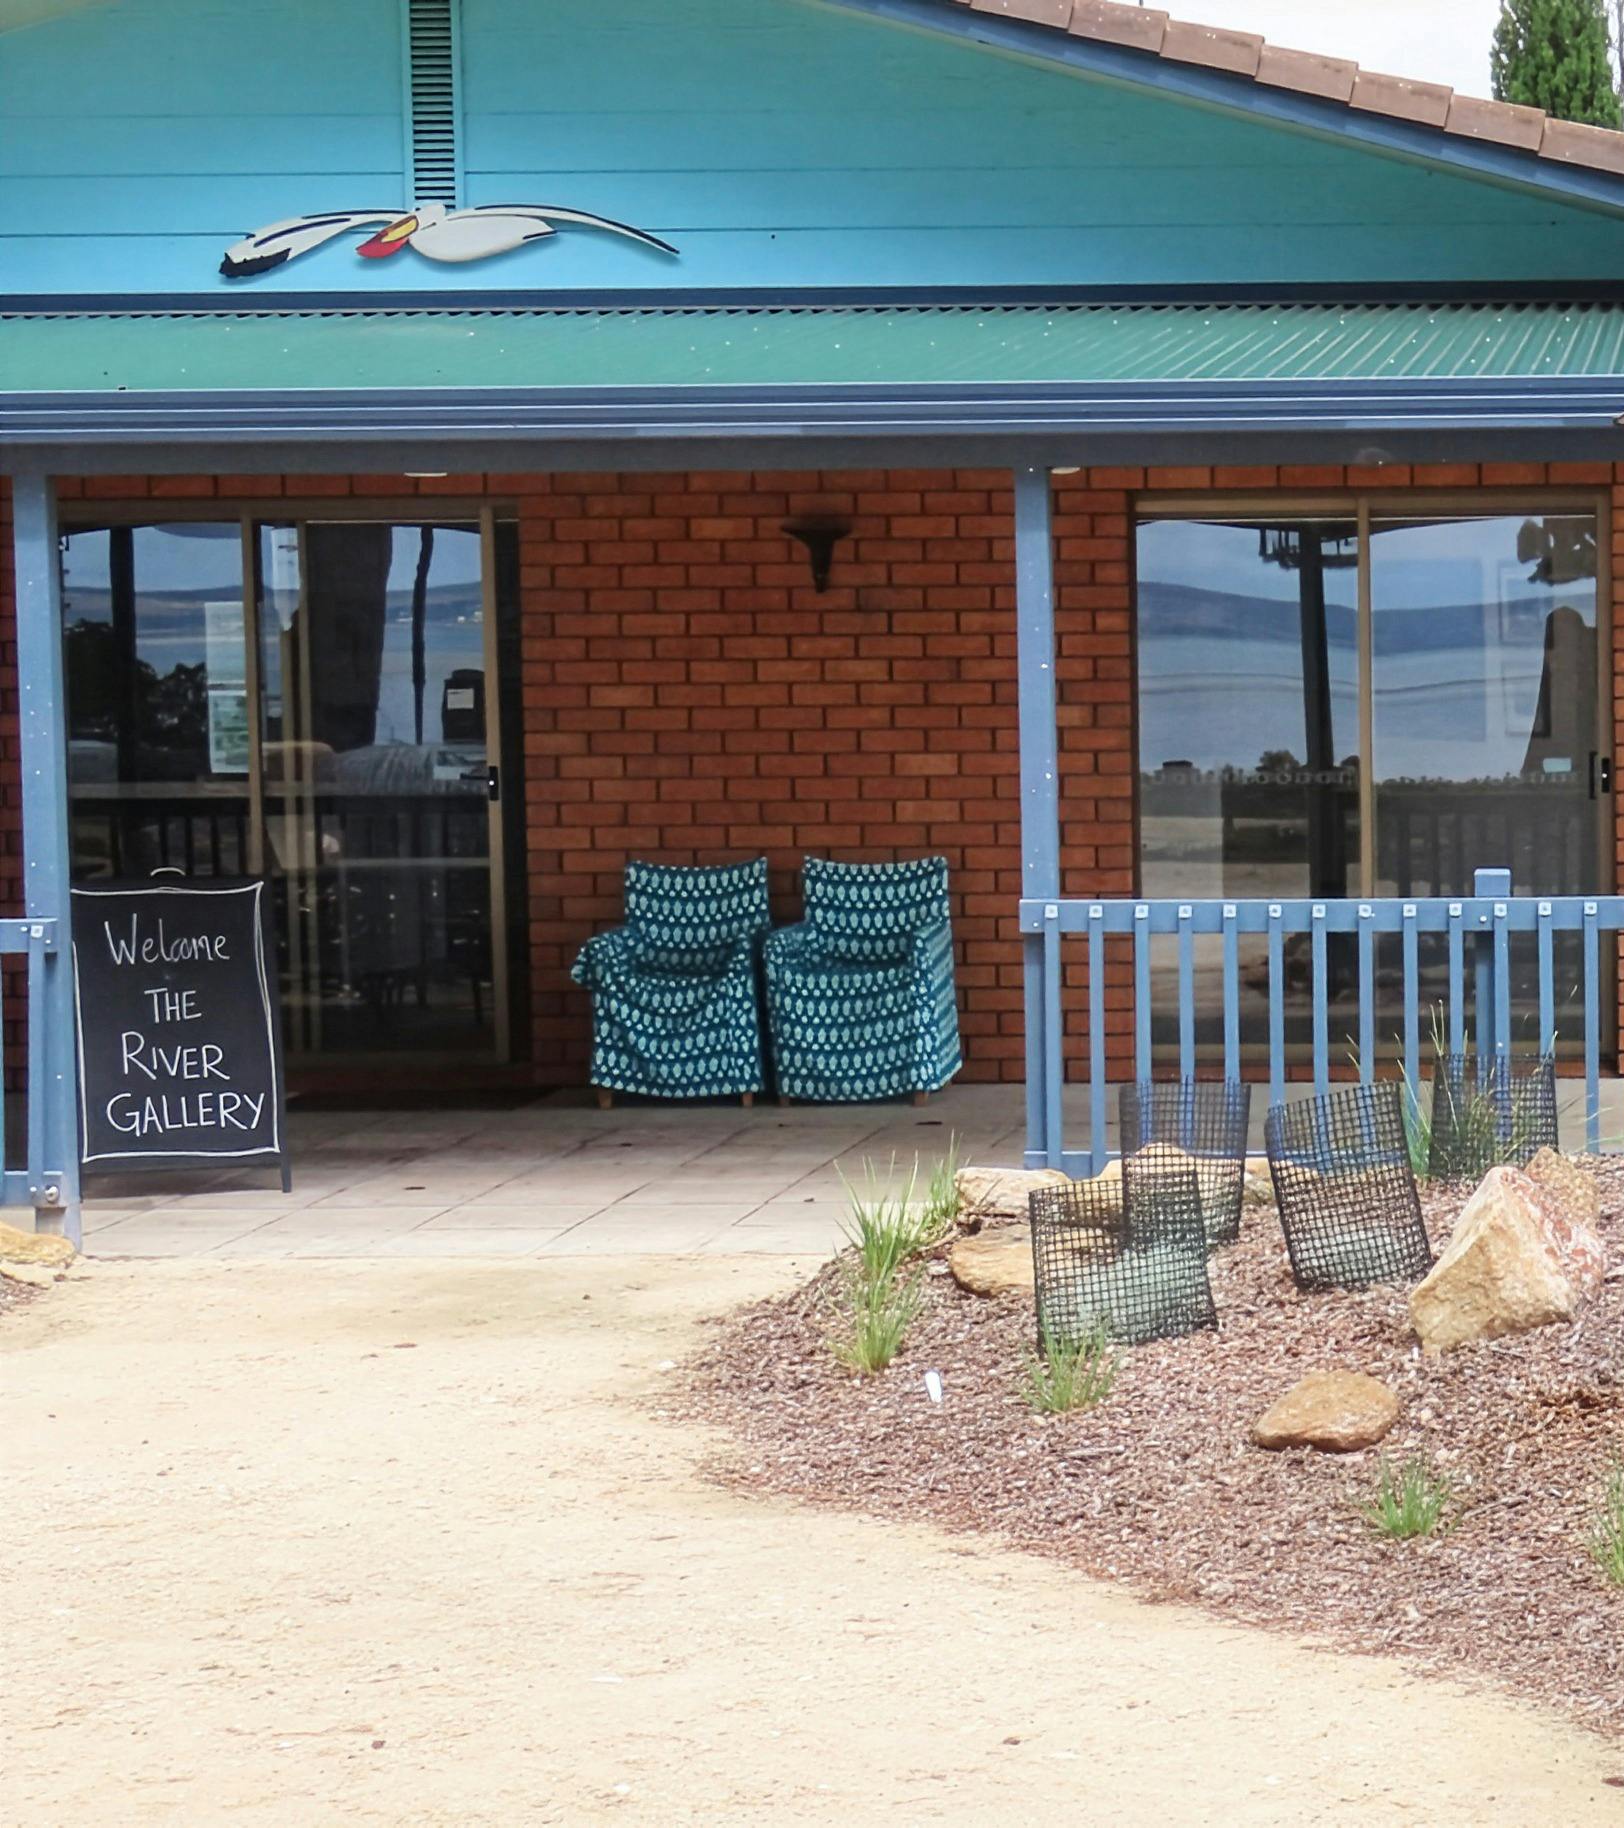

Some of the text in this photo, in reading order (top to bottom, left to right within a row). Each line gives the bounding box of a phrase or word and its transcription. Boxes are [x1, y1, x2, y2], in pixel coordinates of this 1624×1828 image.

[104, 913, 229, 965] Welcome
[144, 987, 202, 1023] THE
[121, 1031, 231, 1081] RIVER
[106, 1092, 265, 1137] GALLERY
